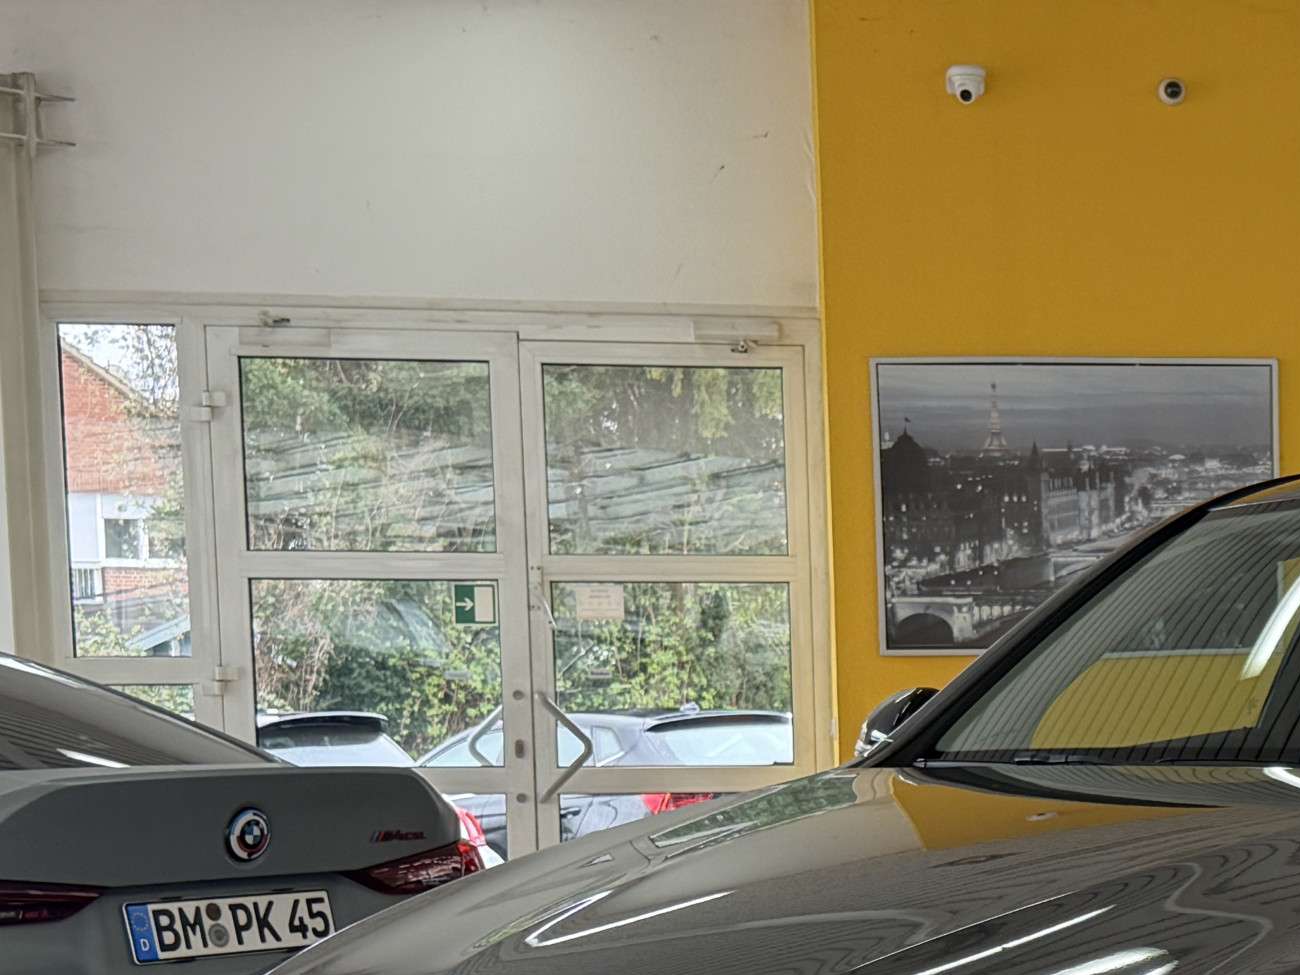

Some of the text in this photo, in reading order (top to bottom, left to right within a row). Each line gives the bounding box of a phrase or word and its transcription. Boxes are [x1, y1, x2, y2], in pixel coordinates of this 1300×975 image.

[152, 897, 330, 952] BM PK 45
[140, 939, 150, 951] D
